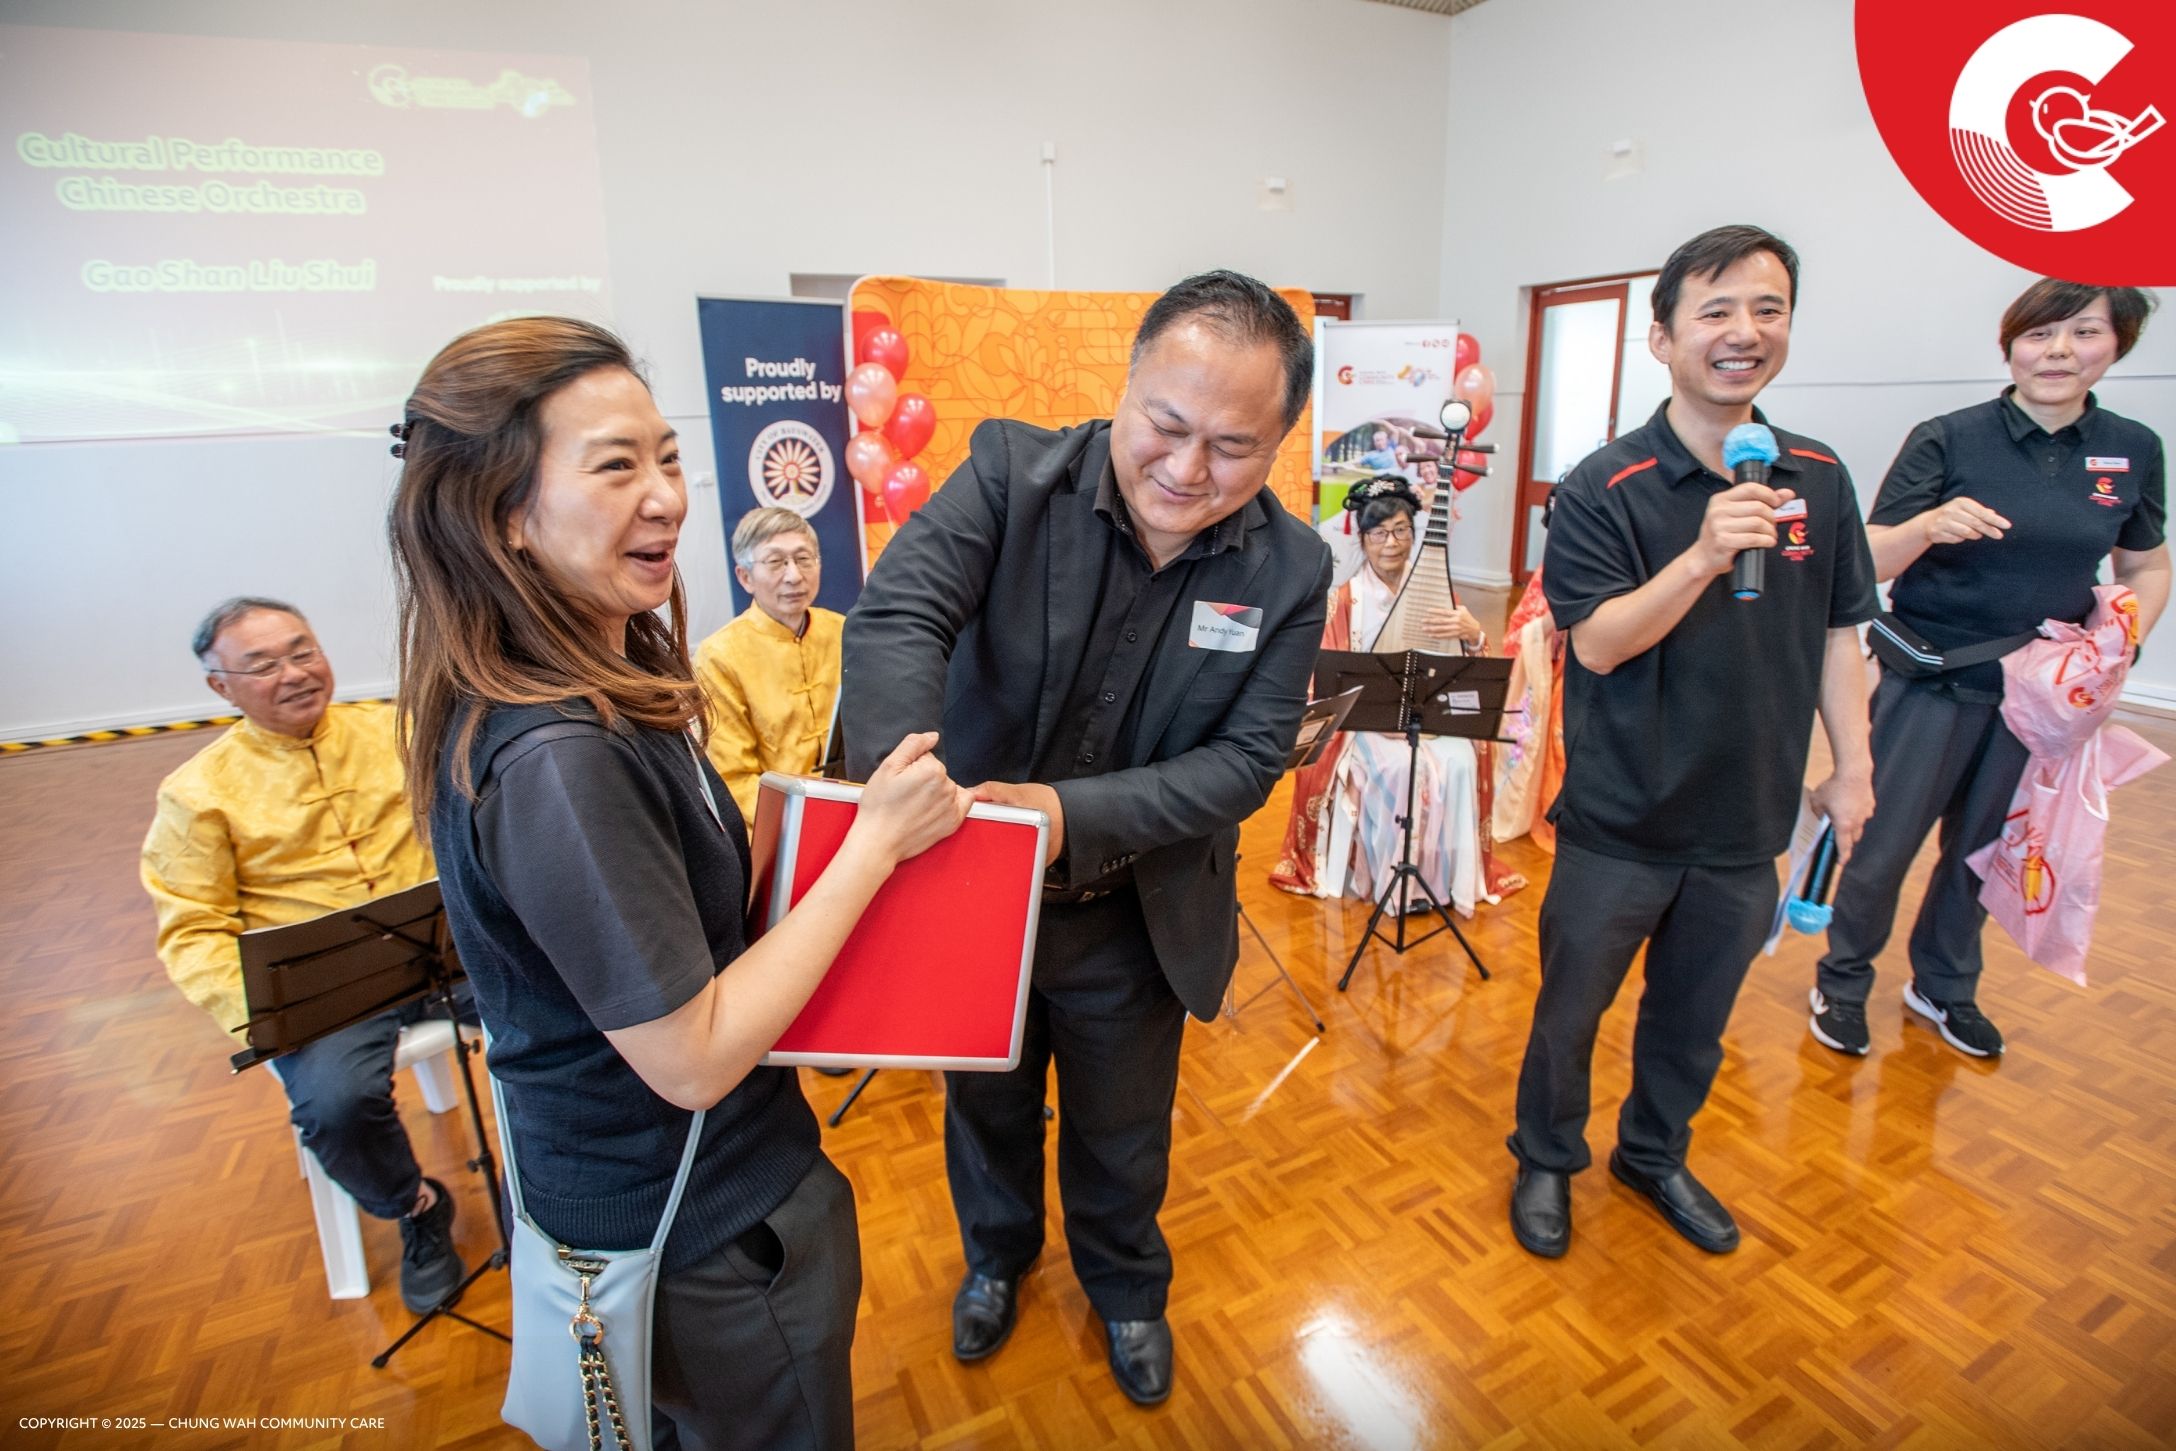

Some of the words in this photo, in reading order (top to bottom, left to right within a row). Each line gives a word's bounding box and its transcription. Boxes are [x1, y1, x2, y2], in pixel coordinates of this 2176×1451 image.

[20, 135, 164, 168] Cultural
[172, 138, 382, 172] Performance
[61, 177, 198, 209] Chinese
[204, 182, 364, 211] Orchestra
[85, 261, 152, 288] Gao
[158, 260, 245, 288] Shan
[252, 260, 298, 288] Liu
[305, 260, 374, 288] Shui
[433, 275, 494, 294] Proudly
[744, 357, 816, 381] Proudly
[721, 382, 817, 406] supported
[820, 381, 842, 403] by
[1197, 624, 1208, 632] Mr
[1210, 625, 1227, 637] Andy
